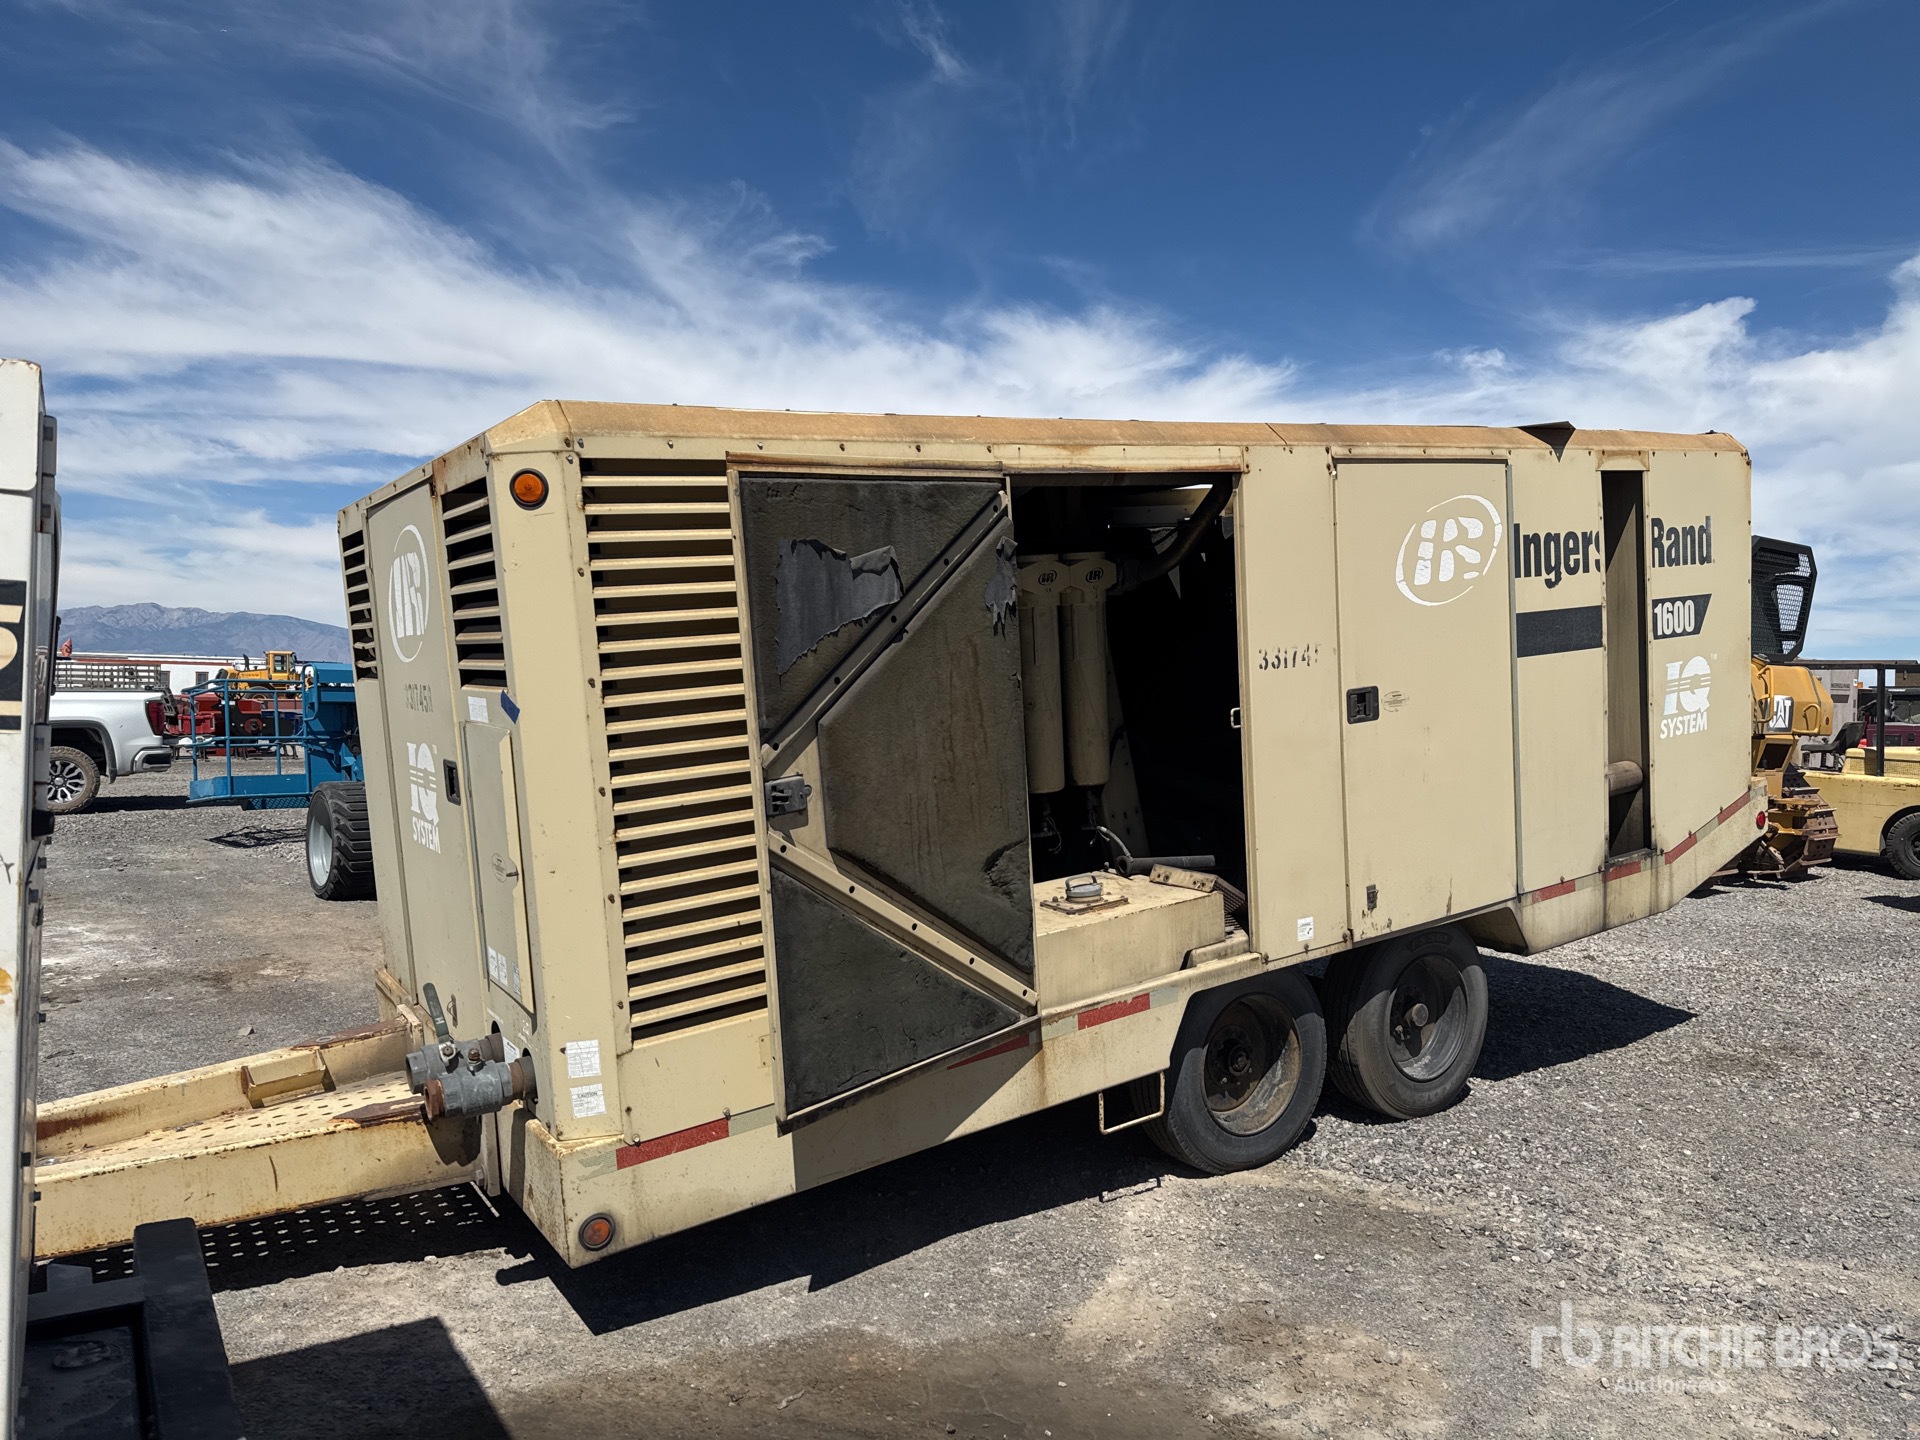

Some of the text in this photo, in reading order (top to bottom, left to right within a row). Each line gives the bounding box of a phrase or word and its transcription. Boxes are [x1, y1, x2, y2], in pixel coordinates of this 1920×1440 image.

[1651, 515, 1711, 568] Rand
[1654, 600, 1695, 636] 1600
[1660, 711, 1708, 739] SYSTEM
[412, 815, 441, 854] SYSTEM
